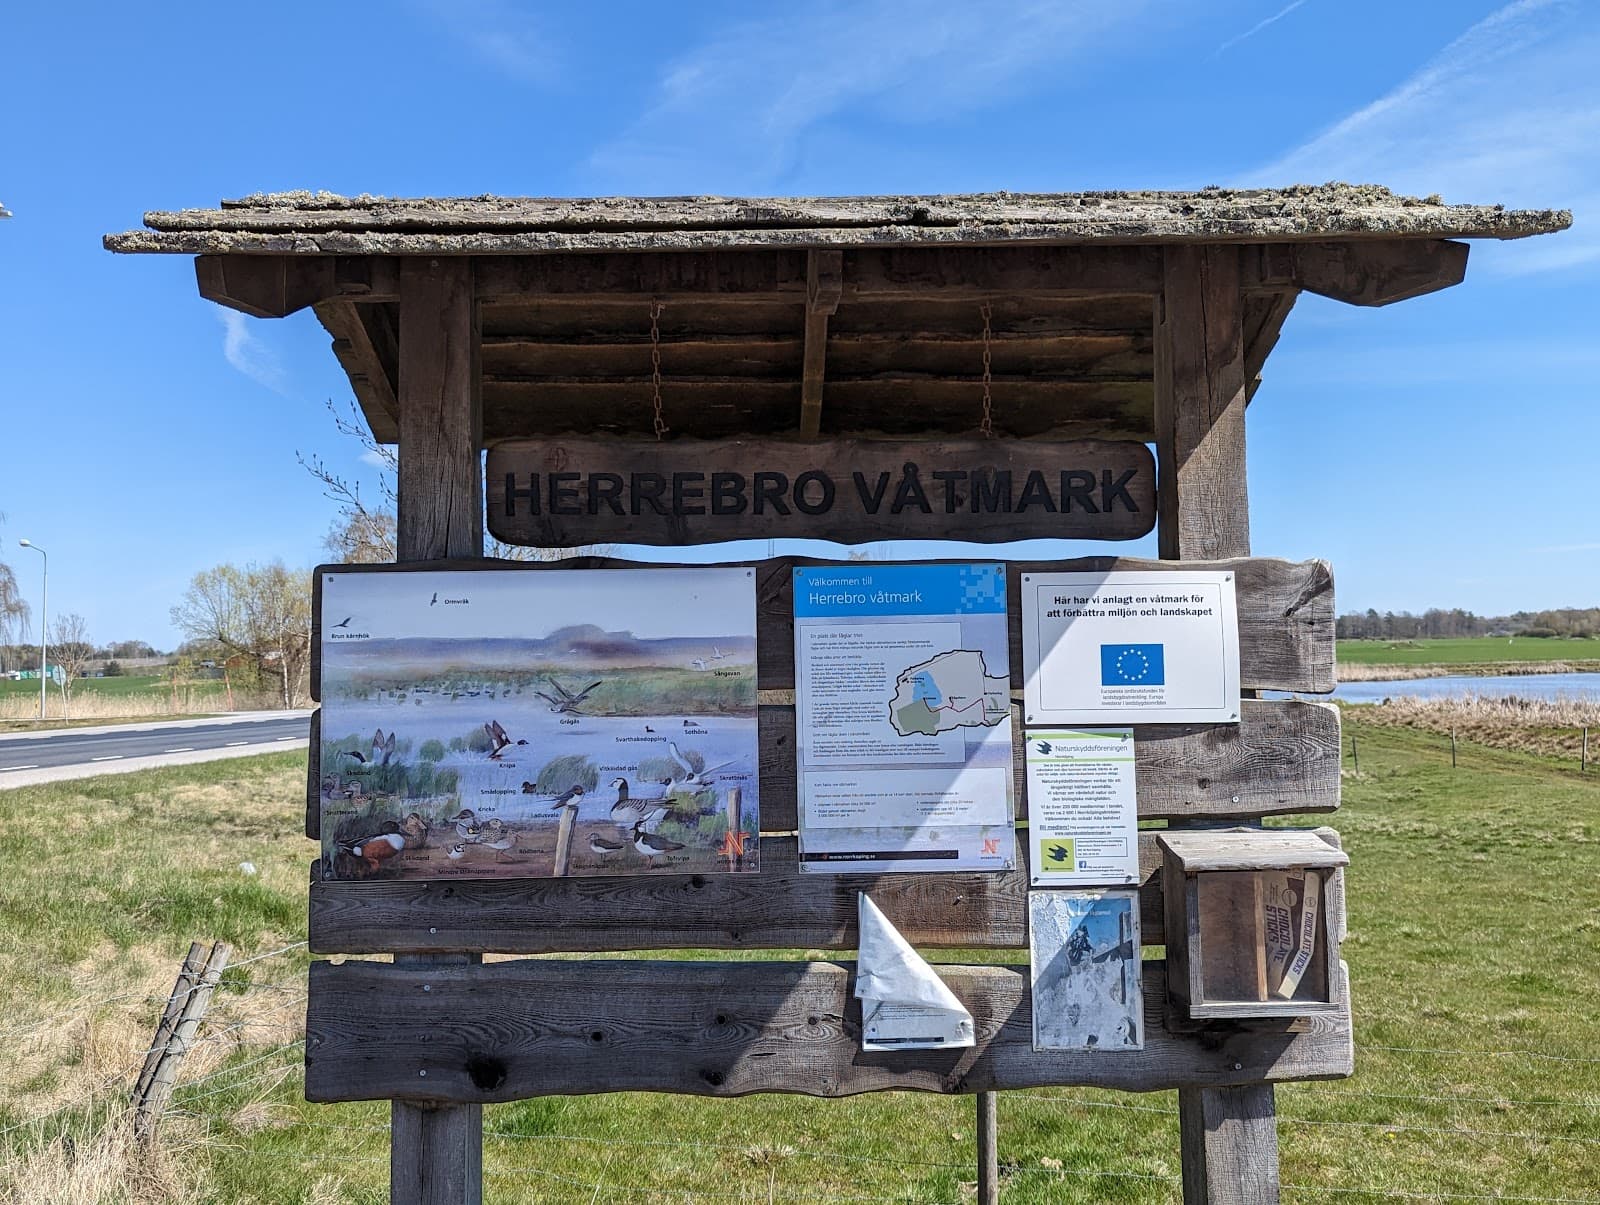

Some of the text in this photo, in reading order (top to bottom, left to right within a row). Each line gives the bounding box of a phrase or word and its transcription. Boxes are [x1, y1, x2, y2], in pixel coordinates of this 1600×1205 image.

[505, 461, 1140, 517] HERREBRO VÅTMARK
[807, 576, 873, 587] Välkommen till
[809, 589, 922, 605] Herrebro våtmark
[1054, 593, 1204, 606] Här har vi anlagt en våtmark för
[1047, 607, 1213, 618] att förbättra miljön och landskapet
[559, 718, 580, 726] Grågås
[1055, 743, 1128, 753] Naturskyddsföreningen
[1266, 904, 1279, 943] STICKS
[1303, 911, 1314, 952] CHOCOLATE
[1274, 907, 1291, 963] CHOCOLATE
[1293, 950, 1310, 976] STICKS
